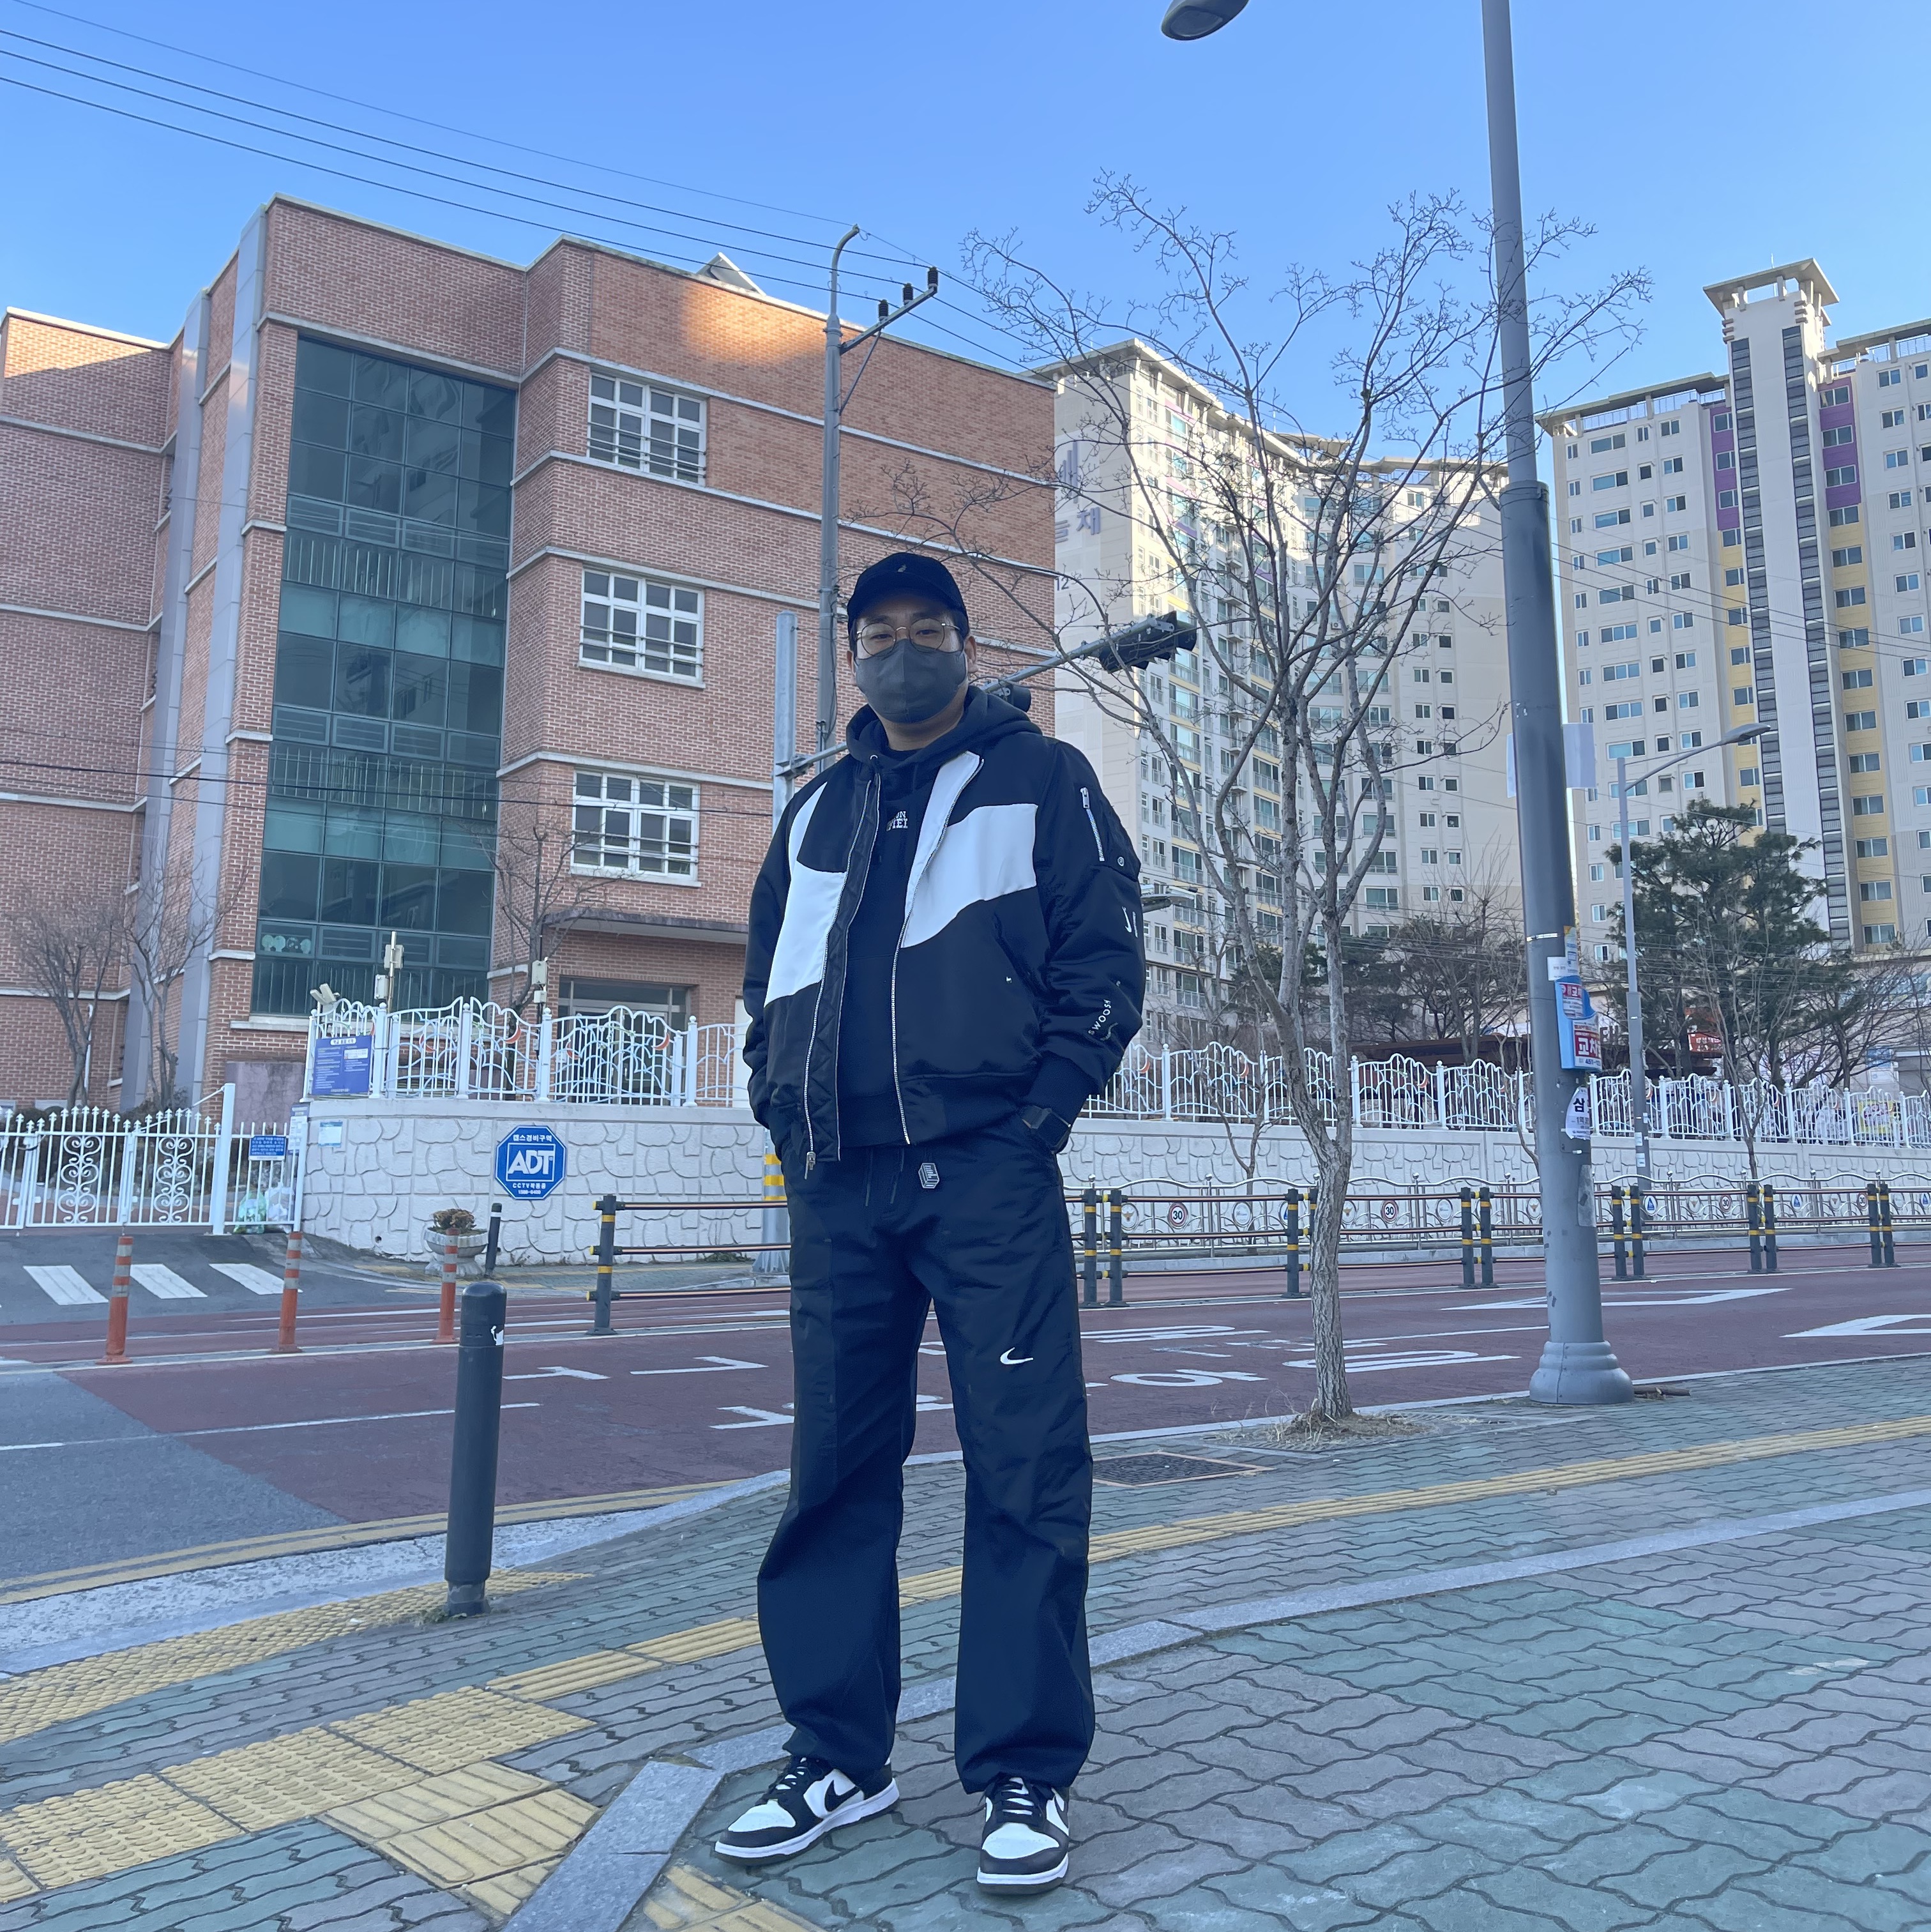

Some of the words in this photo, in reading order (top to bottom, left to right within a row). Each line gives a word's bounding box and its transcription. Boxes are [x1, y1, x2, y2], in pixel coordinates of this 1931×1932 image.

[1087, 999, 1112, 1035] SWOOSH
[508, 1150, 554, 1175] ADT
[1173, 1210, 1183, 1220] 30
[1385, 1206, 1395, 1215] 30
